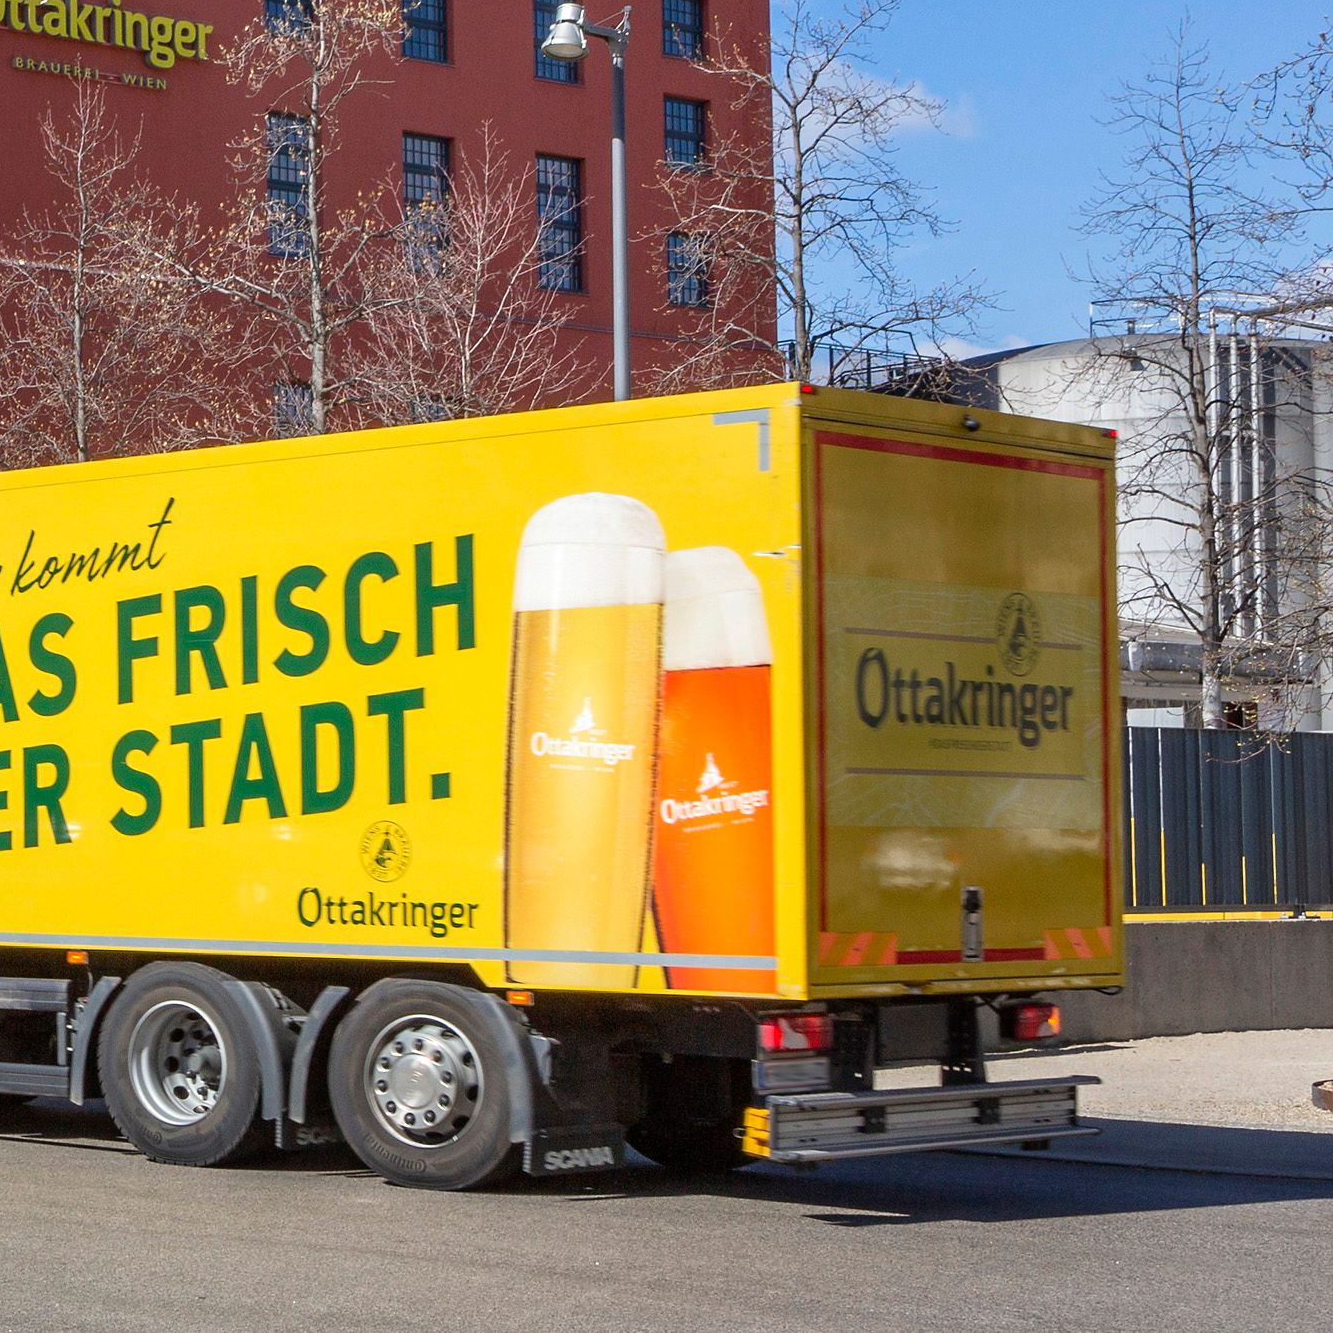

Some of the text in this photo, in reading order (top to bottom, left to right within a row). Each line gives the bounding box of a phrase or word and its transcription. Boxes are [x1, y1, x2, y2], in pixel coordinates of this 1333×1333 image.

[14, 56, 100, 81] BRAUEREI
[121, 72, 167, 90] WIEN
[10, 497, 176, 595] kommt
[116, 533, 476, 705] FRISCH
[855, 647, 1075, 749] Ottakringer
[110, 687, 452, 837] STADT.
[530, 731, 636, 765] Ottakringer
[660, 790, 769, 825] Ottakringer
[297, 886, 480, 939] Ottakringer
[543, 1146, 615, 1171] SCANIA
